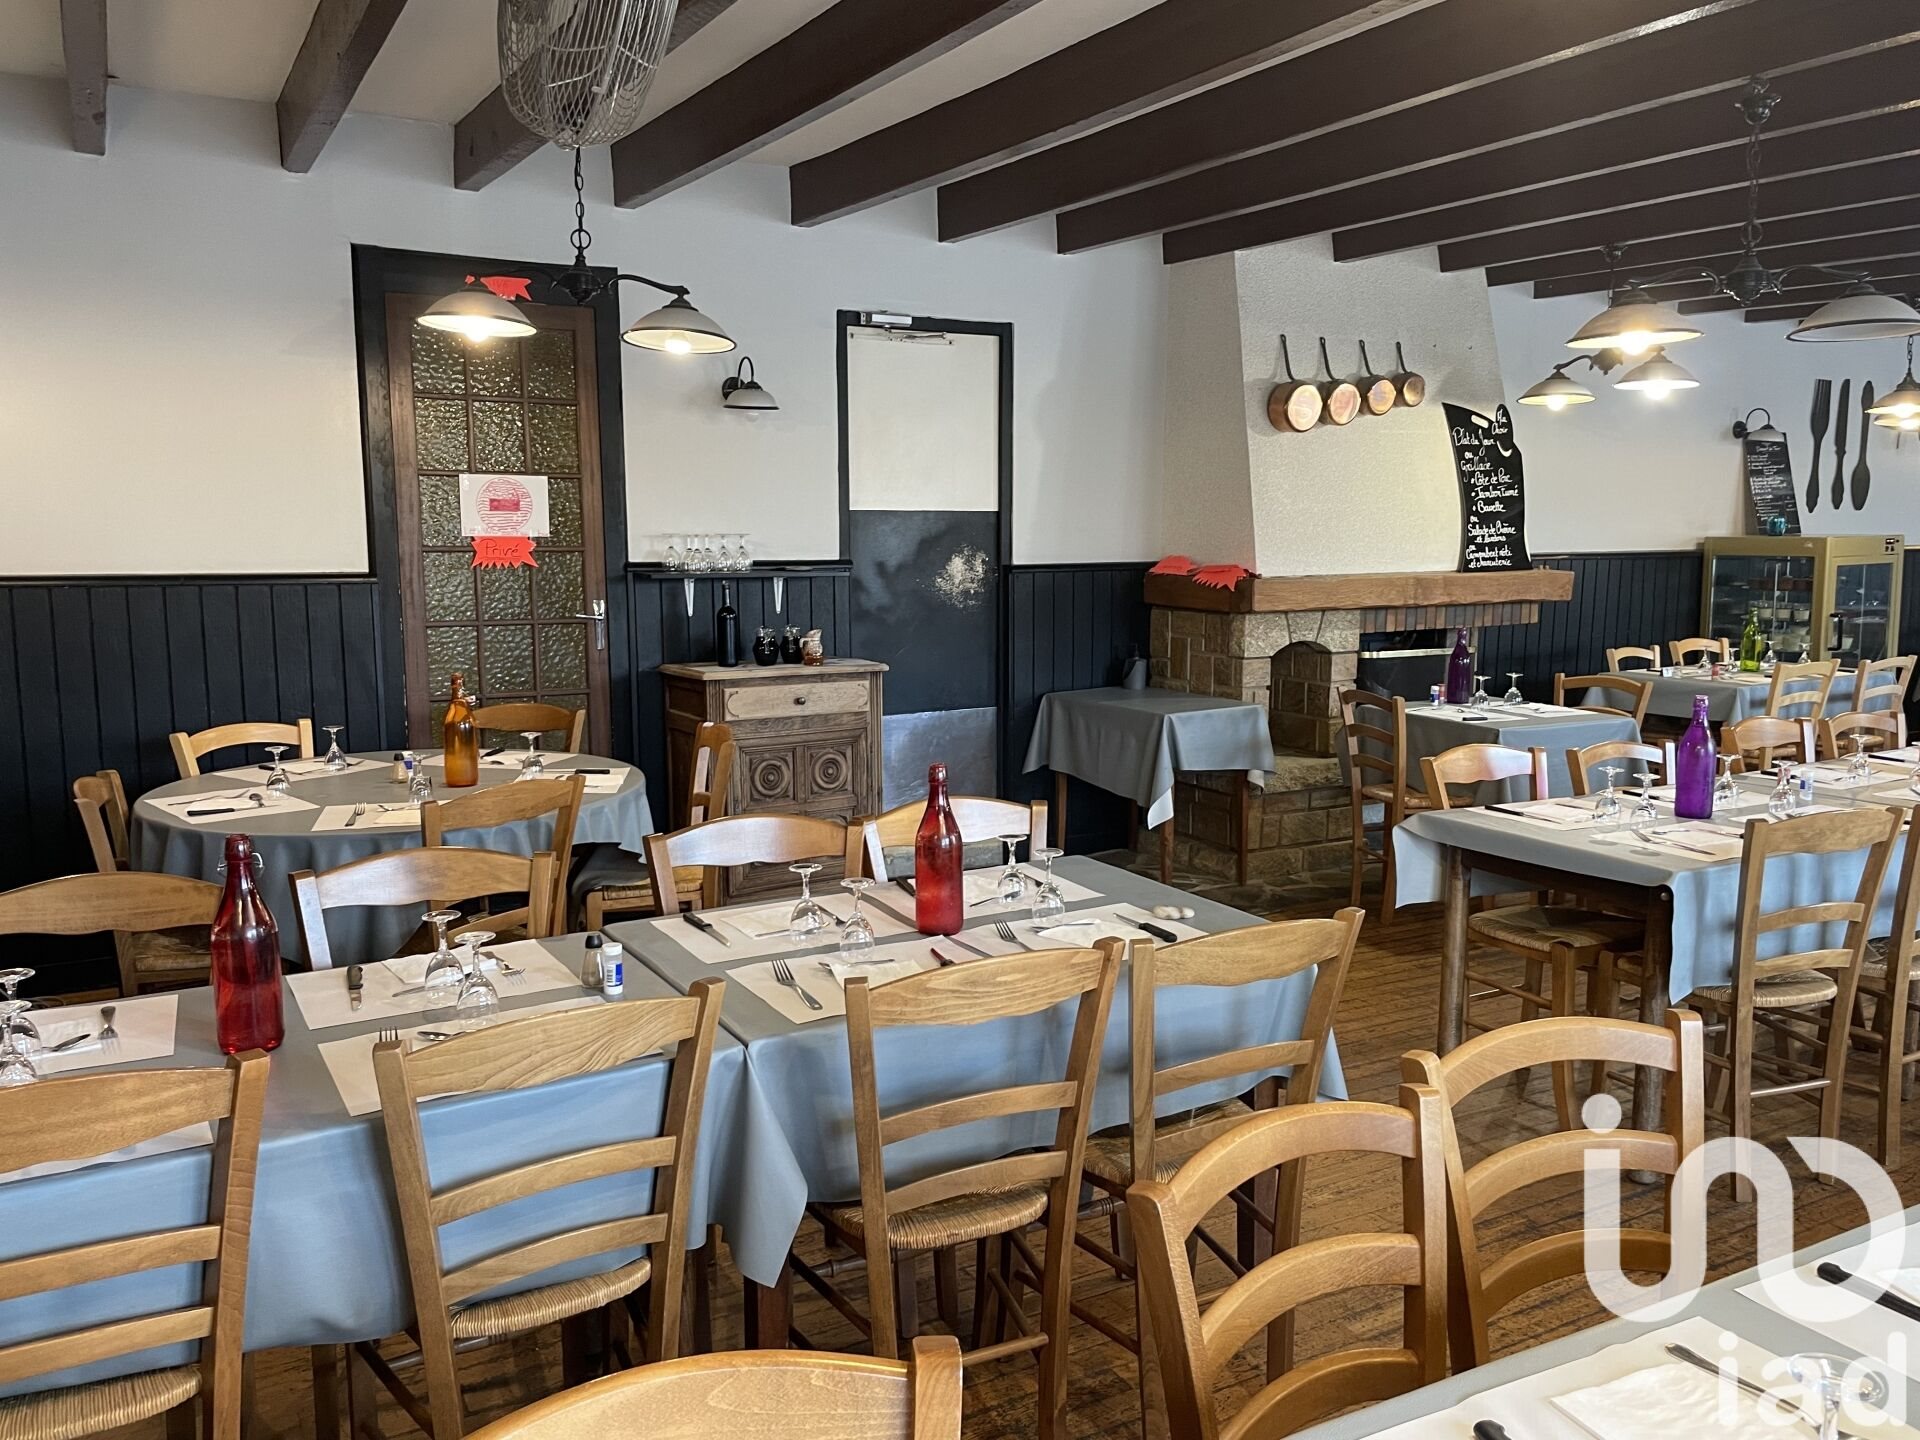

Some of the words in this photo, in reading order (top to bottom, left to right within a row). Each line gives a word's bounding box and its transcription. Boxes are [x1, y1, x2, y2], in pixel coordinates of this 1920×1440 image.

[1452, 427, 1470, 446] Plat
[1471, 433, 1480, 444] du
[1478, 428, 1496, 456] Jour
[1460, 456, 1494, 482] Grillade
[1491, 472, 1498, 484] de
[1498, 468, 1513, 483] Porc
[1477, 500, 1507, 514] Bavette
[1468, 524, 1489, 536] Salade
[1489, 523, 1496, 535] de
[480, 538, 520, 558] Privé
[1466, 546, 1498, 559] Camembert
